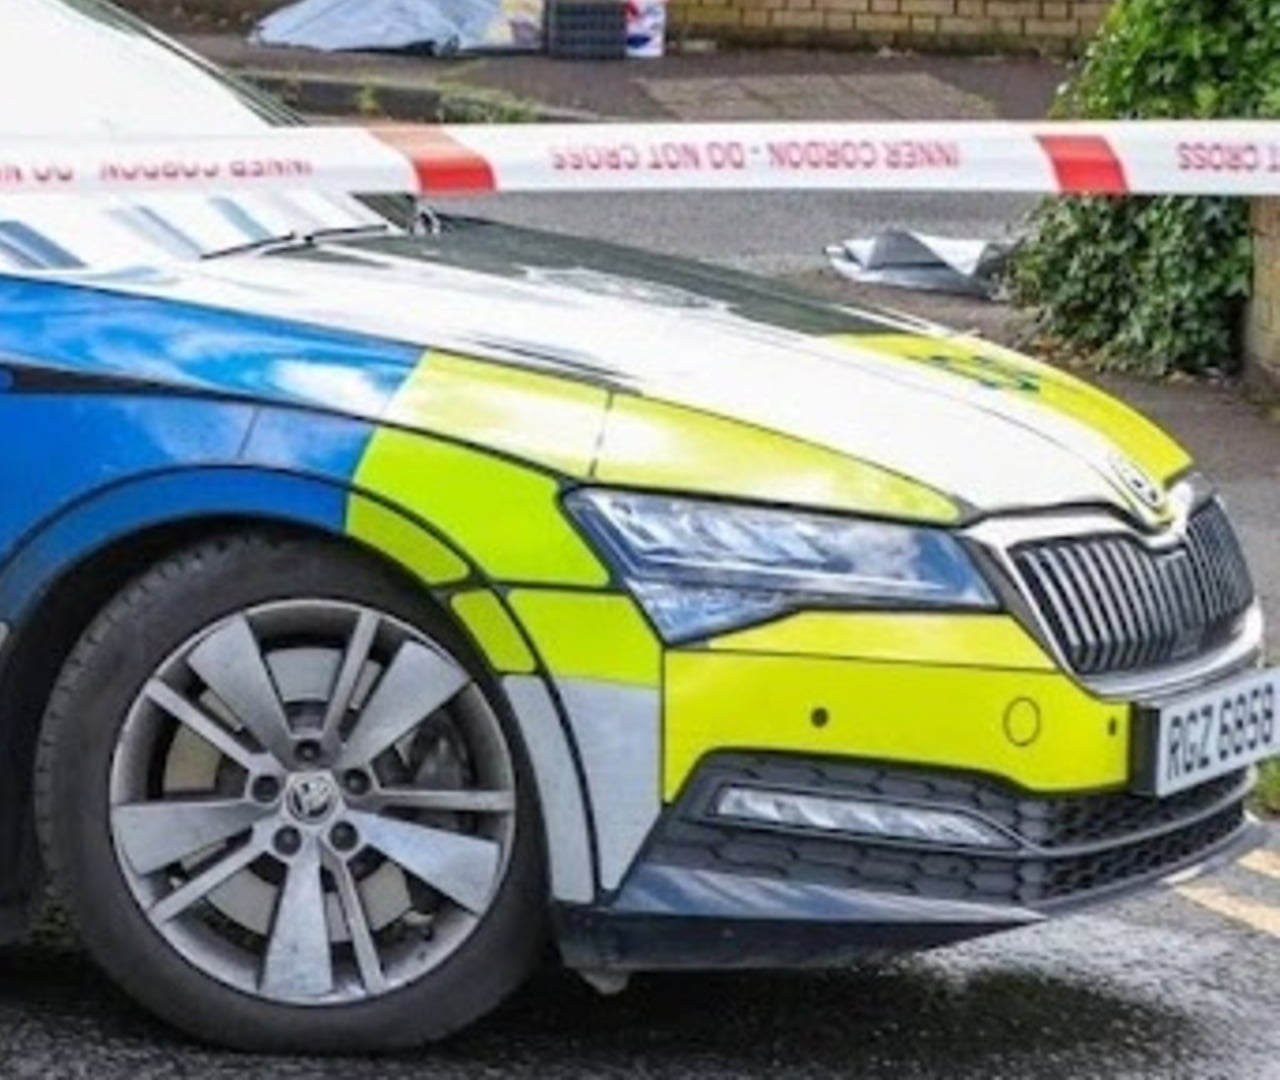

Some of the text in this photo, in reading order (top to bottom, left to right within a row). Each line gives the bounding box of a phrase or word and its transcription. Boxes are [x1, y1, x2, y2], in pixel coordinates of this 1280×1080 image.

[552, 143, 639, 171] CROSS
[649, 142, 700, 170] NOT
[707, 141, 745, 170] DO
[767, 141, 875, 169] CORDON
[885, 141, 959, 169] INNER
[1177, 141, 1259, 172] CROSS
